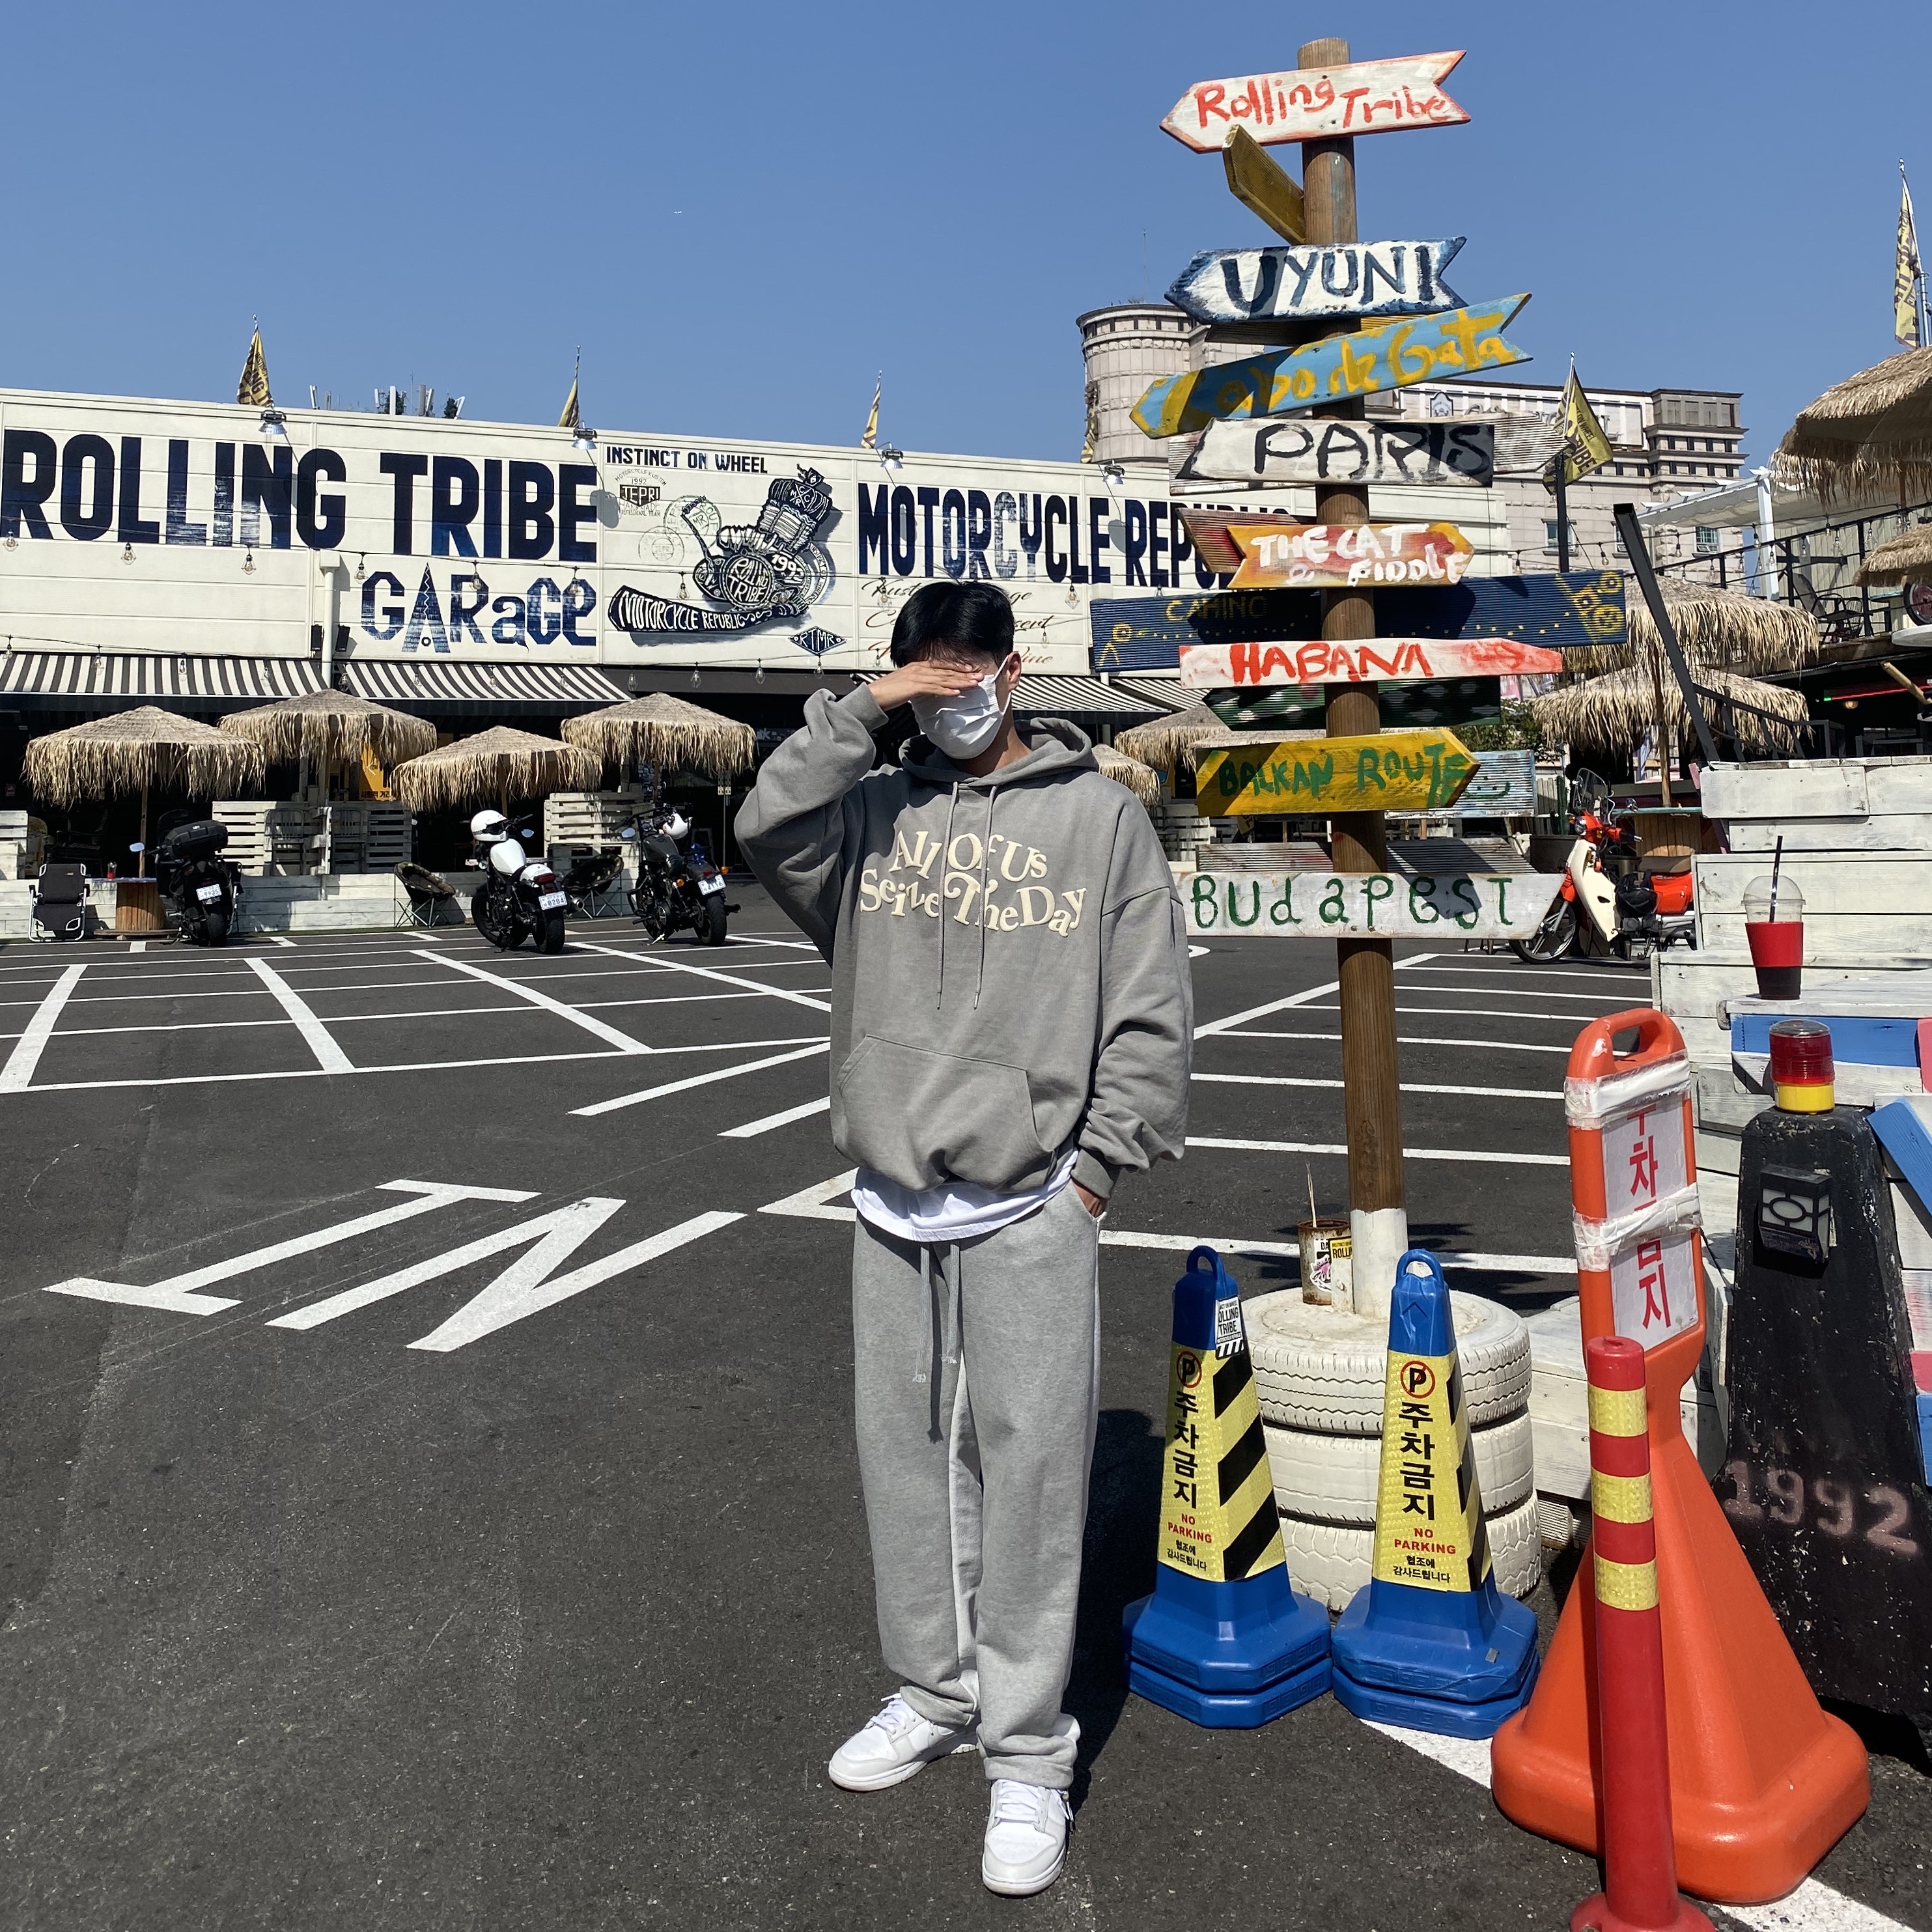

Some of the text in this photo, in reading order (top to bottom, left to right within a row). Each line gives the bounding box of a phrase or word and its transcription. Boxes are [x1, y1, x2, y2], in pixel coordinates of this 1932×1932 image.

[1194, 75, 1451, 128] Rolling Tribe
[1220, 245, 1436, 319] UYUNI
[1328, 339, 1381, 393] de
[1389, 308, 1517, 384] Gata
[606, 446, 768, 474] INSTINCT ON WHEEL
[1254, 423, 1492, 483] PARIS
[1, 429, 597, 563] ROLLING TRIBE
[622, 485, 660, 506] JEPRI
[858, 483, 1111, 583] MOTORCYCLE
[1251, 523, 1430, 567] THE CAT
[733, 558, 769, 587] ROLLING
[1347, 543, 1468, 585] FIDDLE
[729, 575, 768, 602] TRIBE
[619, 590, 748, 630] MOTORCYCLE REPUBLIC
[800, 628, 835, 648] RTMR
[1229, 641, 1434, 685] HABANA
[1218, 742, 1468, 808] BALKAN ROUTE
[888, 830, 1048, 882] All Of Us
[860, 868, 1087, 937] Seize The Day
[1218, 1306, 1239, 1323] OLLING
[1218, 1320, 1237, 1336] TRIBE
[1172, 1391, 1199, 1509] 주차금지
[1399, 1401, 1436, 1521] 주차금지
[1181, 1513, 1196, 1526] NO
[1723, 1461, 1918, 1554] 1992
[1168, 1522, 1212, 1544] PARKING
[1176, 1539, 1196, 1556] 협조에
[1394, 1539, 1457, 1554] PARKING
[1414, 1528, 1434, 1538] NO
[1167, 1548, 1207, 1572] 감사드립니다
[1393, 1565, 1451, 1584] 감사드립니다
[1407, 1555, 1436, 1569] 협조에
